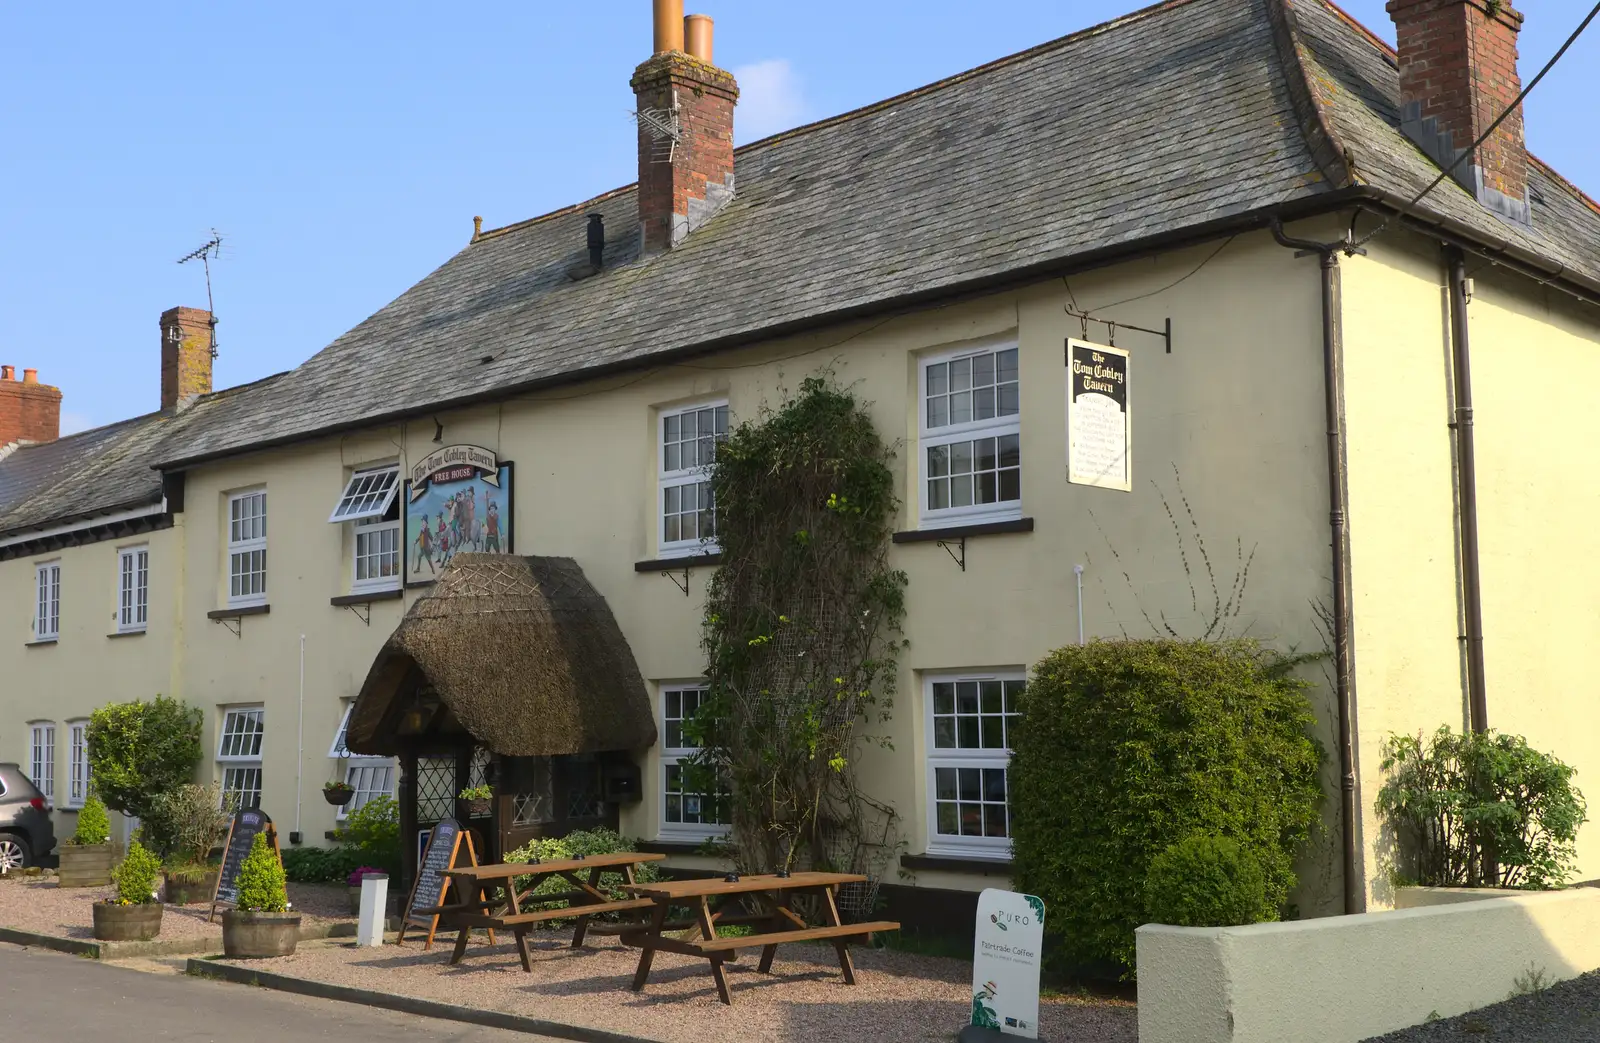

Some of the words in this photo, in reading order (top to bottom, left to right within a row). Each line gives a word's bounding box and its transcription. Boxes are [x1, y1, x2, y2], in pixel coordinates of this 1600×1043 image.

[1092, 352, 1105, 363] The
[1073, 359, 1093, 375] Tom
[1094, 364, 1123, 384] Cobley
[1083, 375, 1114, 393] Tavern
[415, 466, 427, 482] The
[427, 456, 443, 470] Tom
[443, 448, 467, 464] Cobley
[467, 447, 493, 468] Tavern
[434, 471, 450, 482] FREE
[451, 467, 471, 479] HOUSE
[998, 910, 1029, 926] PURO
[981, 940, 1011, 953] Fairtrade
[1012, 946, 1034, 958] Coffee
